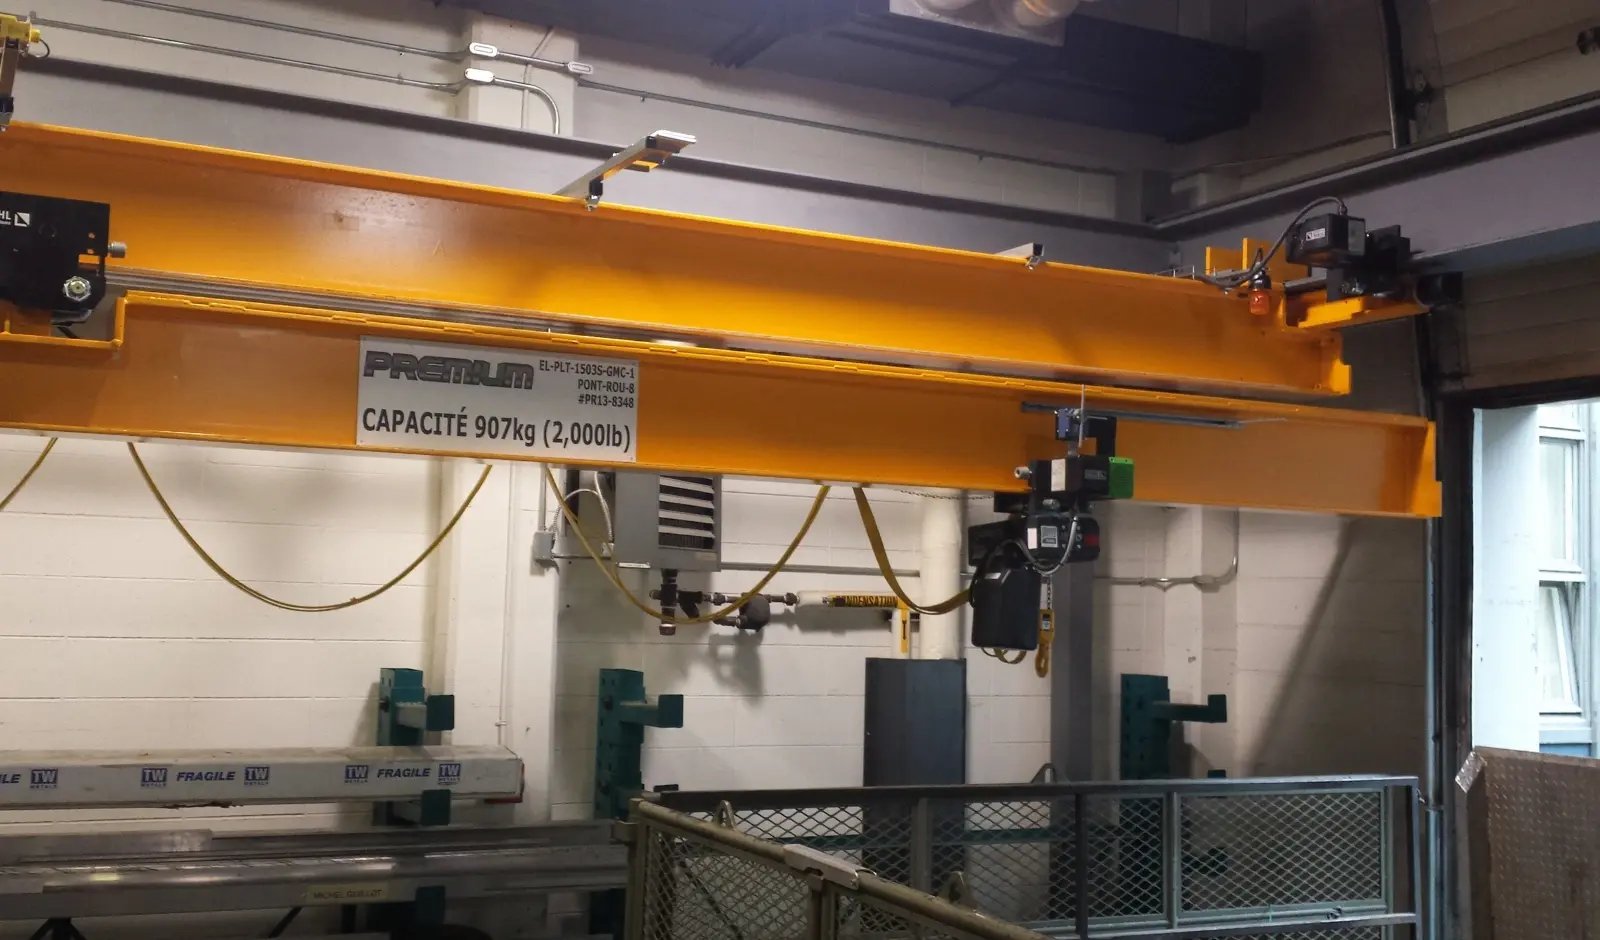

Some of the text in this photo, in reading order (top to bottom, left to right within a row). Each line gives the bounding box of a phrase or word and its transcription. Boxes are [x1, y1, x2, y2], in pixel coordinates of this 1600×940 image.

[363, 350, 534, 390] PREMIUM
[539, 359, 635, 379] EL-PLT-1503S-GMC-1
[577, 379, 635, 394] PONT-ROU-8
[578, 394, 634, 408] #PR13-8348
[362, 407, 631, 453] CAPACITÉ 907kg (2,000lb)
[176, 772, 235, 781] FRAGILE
[377, 768, 430, 778] FRAGILE
